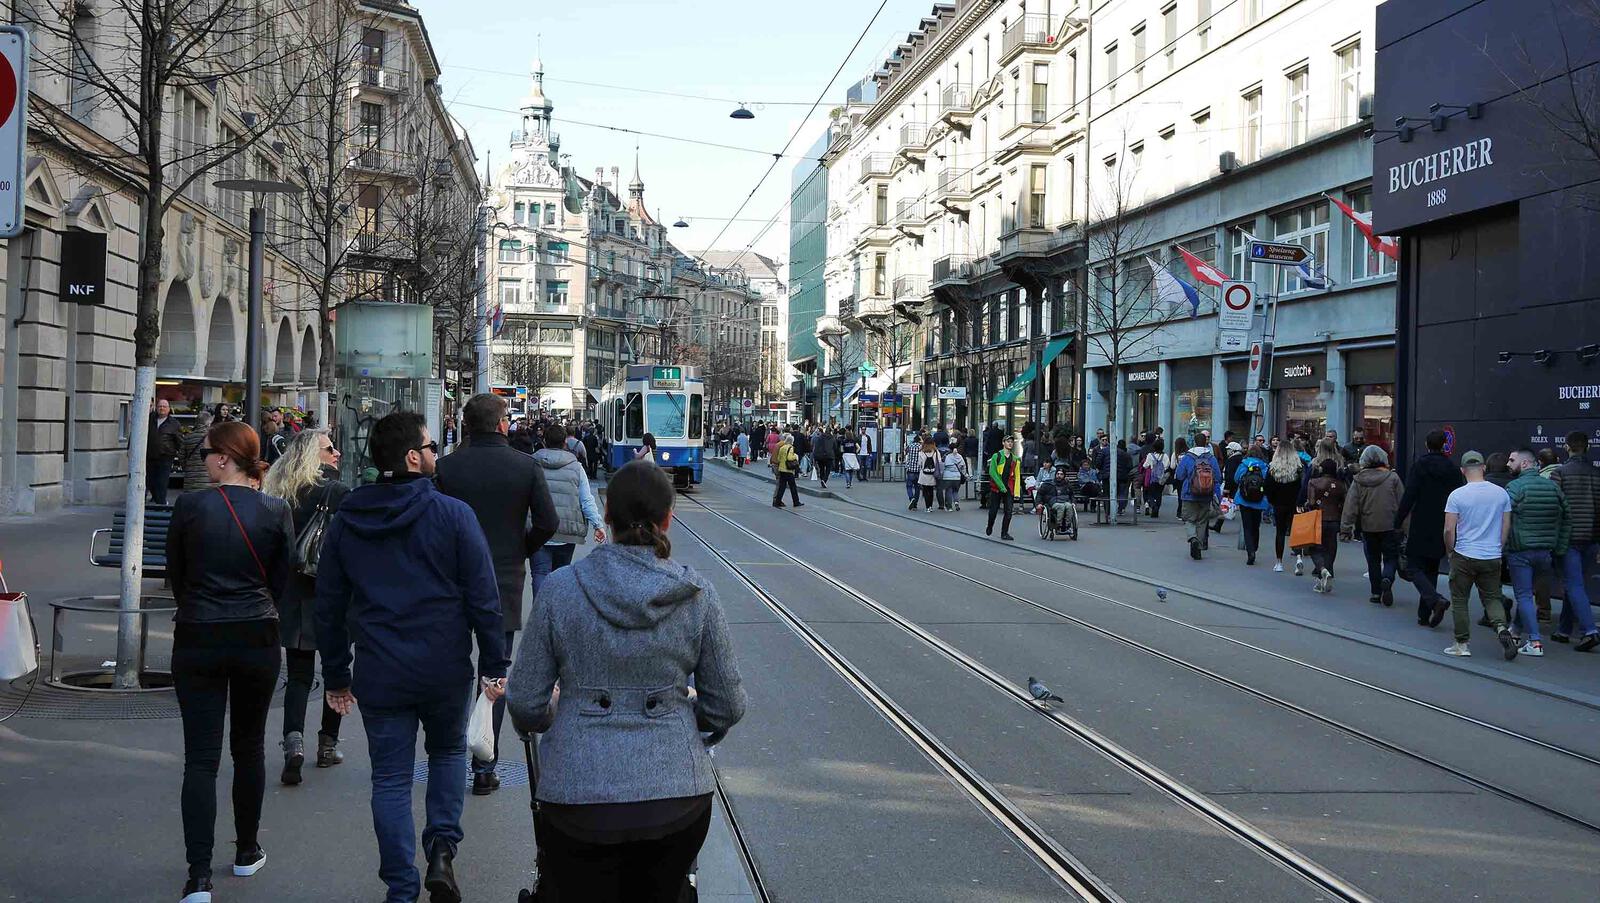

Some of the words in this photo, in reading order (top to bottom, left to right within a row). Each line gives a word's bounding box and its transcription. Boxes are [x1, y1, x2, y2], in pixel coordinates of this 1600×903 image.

[1389, 137, 1494, 194] BUCHERER
[1427, 188, 1447, 207] 1888
[69, 285, 95, 295] NKF
[661, 368, 673, 379] 11
[1284, 364, 1308, 378] swatch
